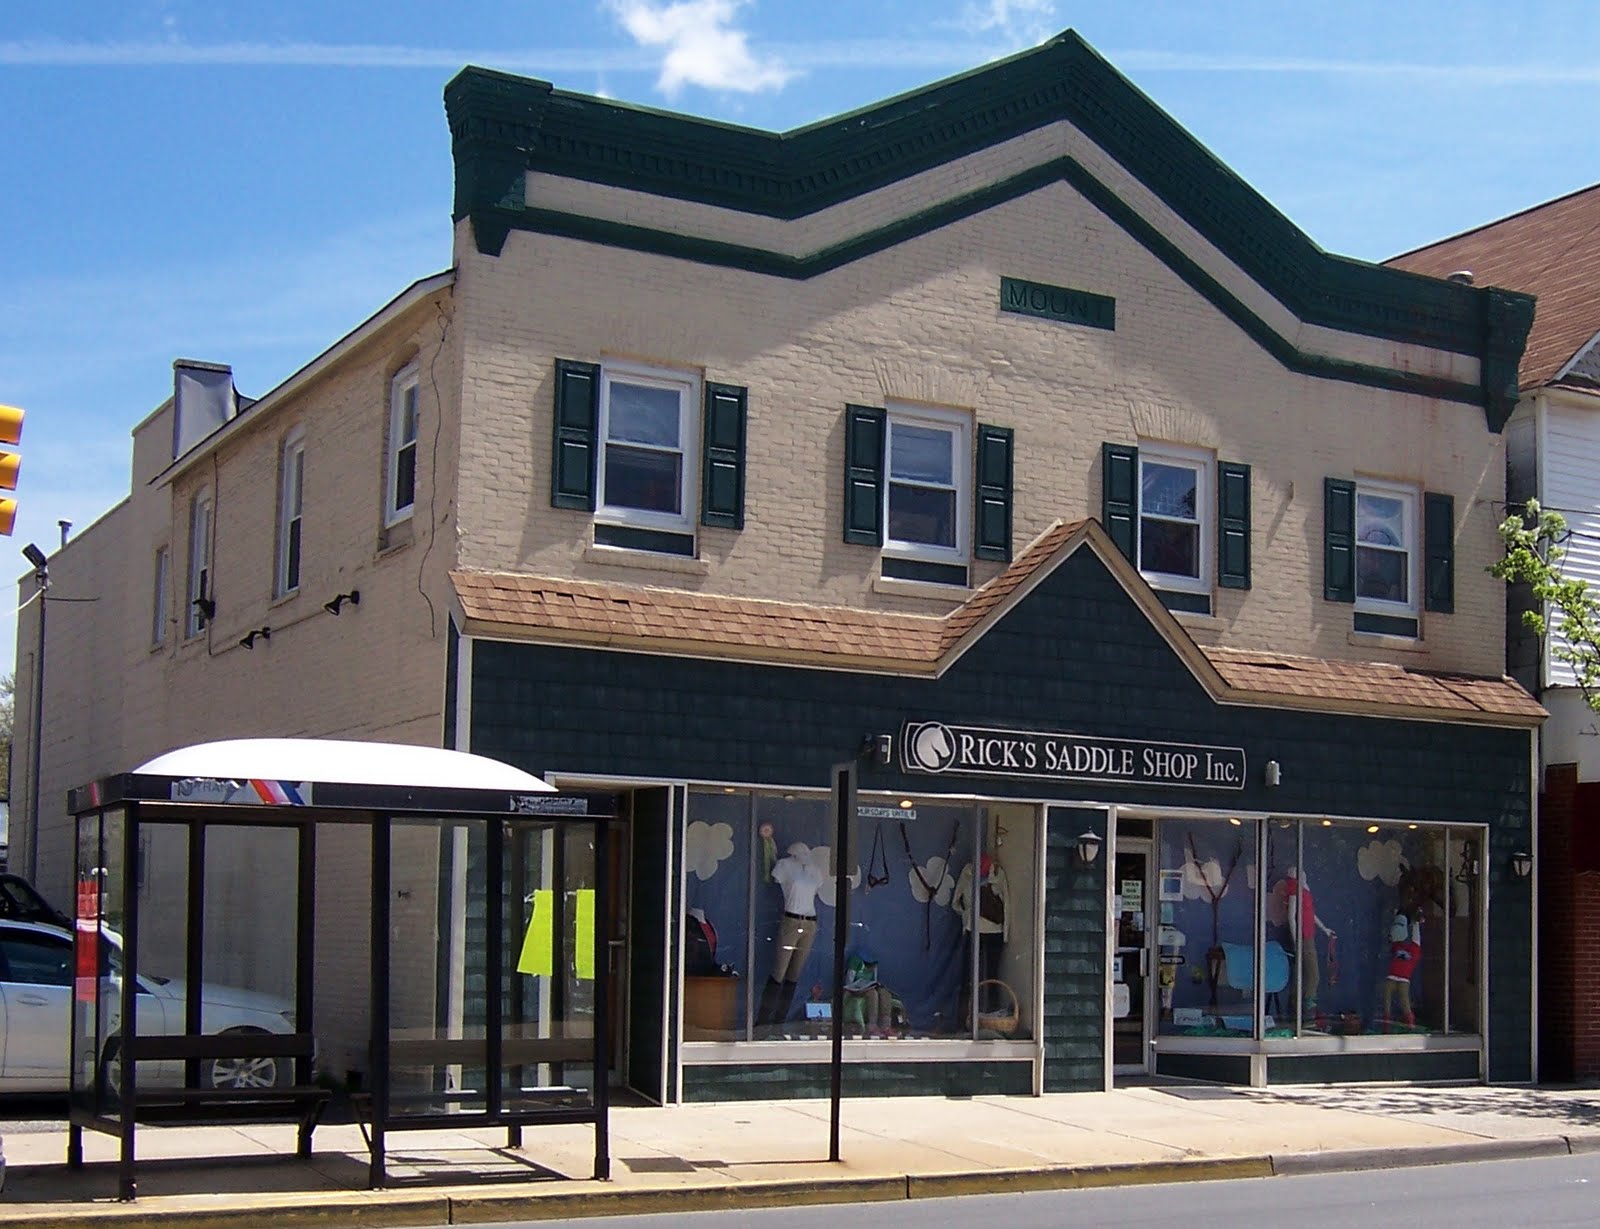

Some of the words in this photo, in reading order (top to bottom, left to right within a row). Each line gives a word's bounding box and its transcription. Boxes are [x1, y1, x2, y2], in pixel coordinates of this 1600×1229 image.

[1008, 283, 1110, 321] MOUNT
[959, 734, 1037, 769] RICK'S
[1045, 741, 1135, 775] SADDLE
[1143, 748, 1198, 779] SHOP
[1205, 752, 1239, 782] Inc.
